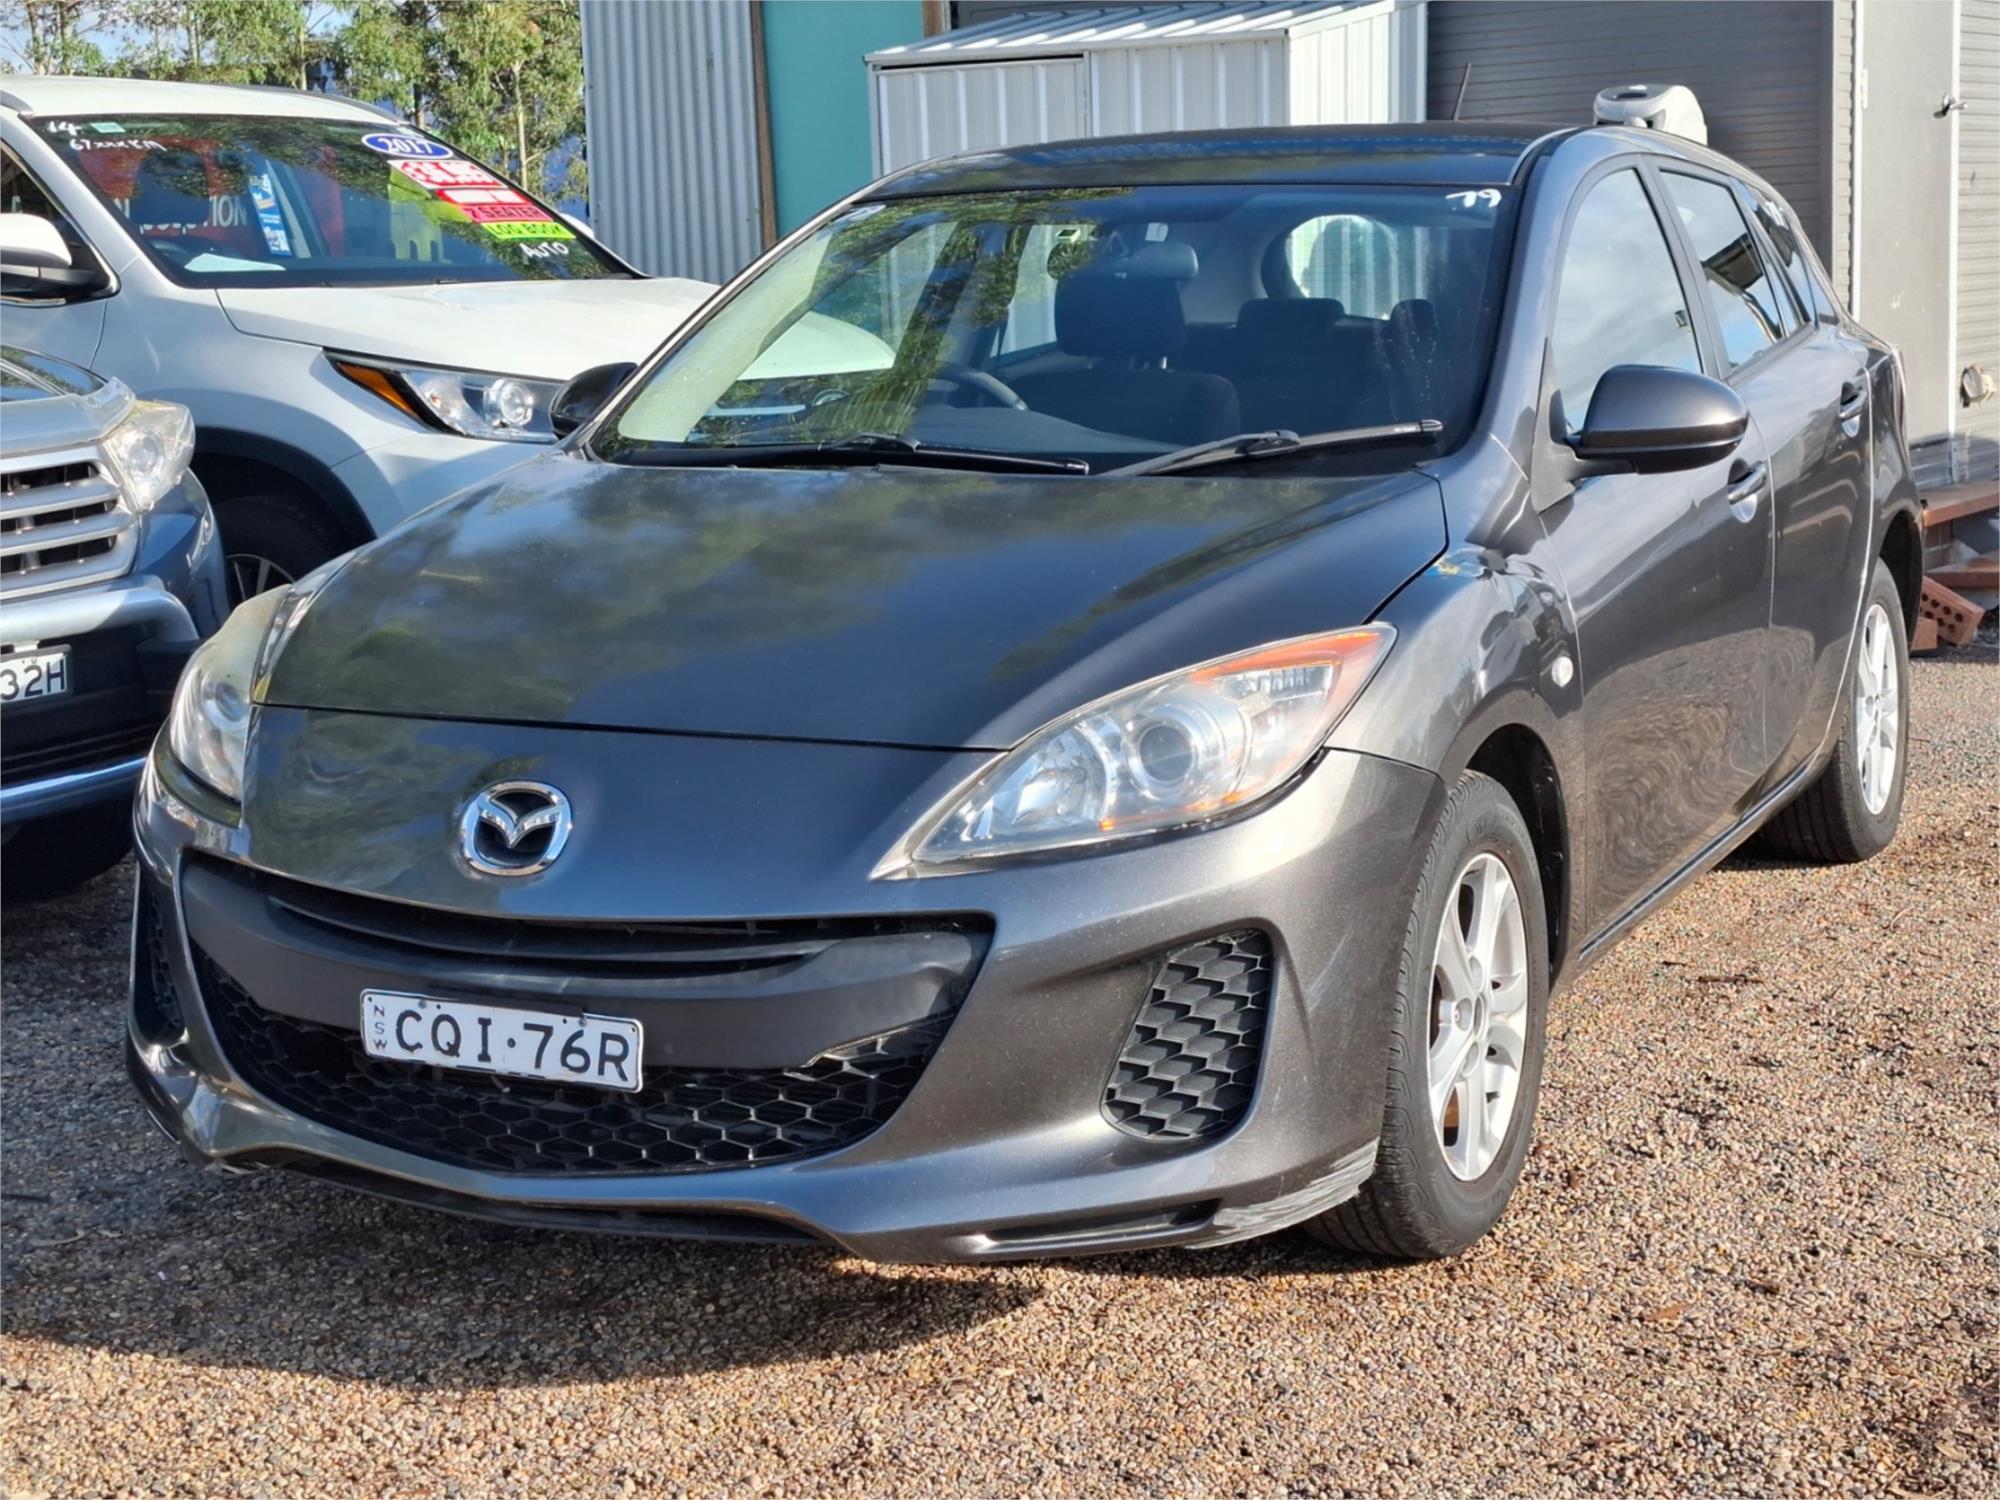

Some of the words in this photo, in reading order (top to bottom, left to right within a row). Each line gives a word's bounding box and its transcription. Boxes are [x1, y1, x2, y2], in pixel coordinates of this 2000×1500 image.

[378, 137, 434, 155] 2017
[478, 206, 543, 219] SEATER
[519, 242, 569, 258] AUTO
[0, 658, 65, 700] 32H
